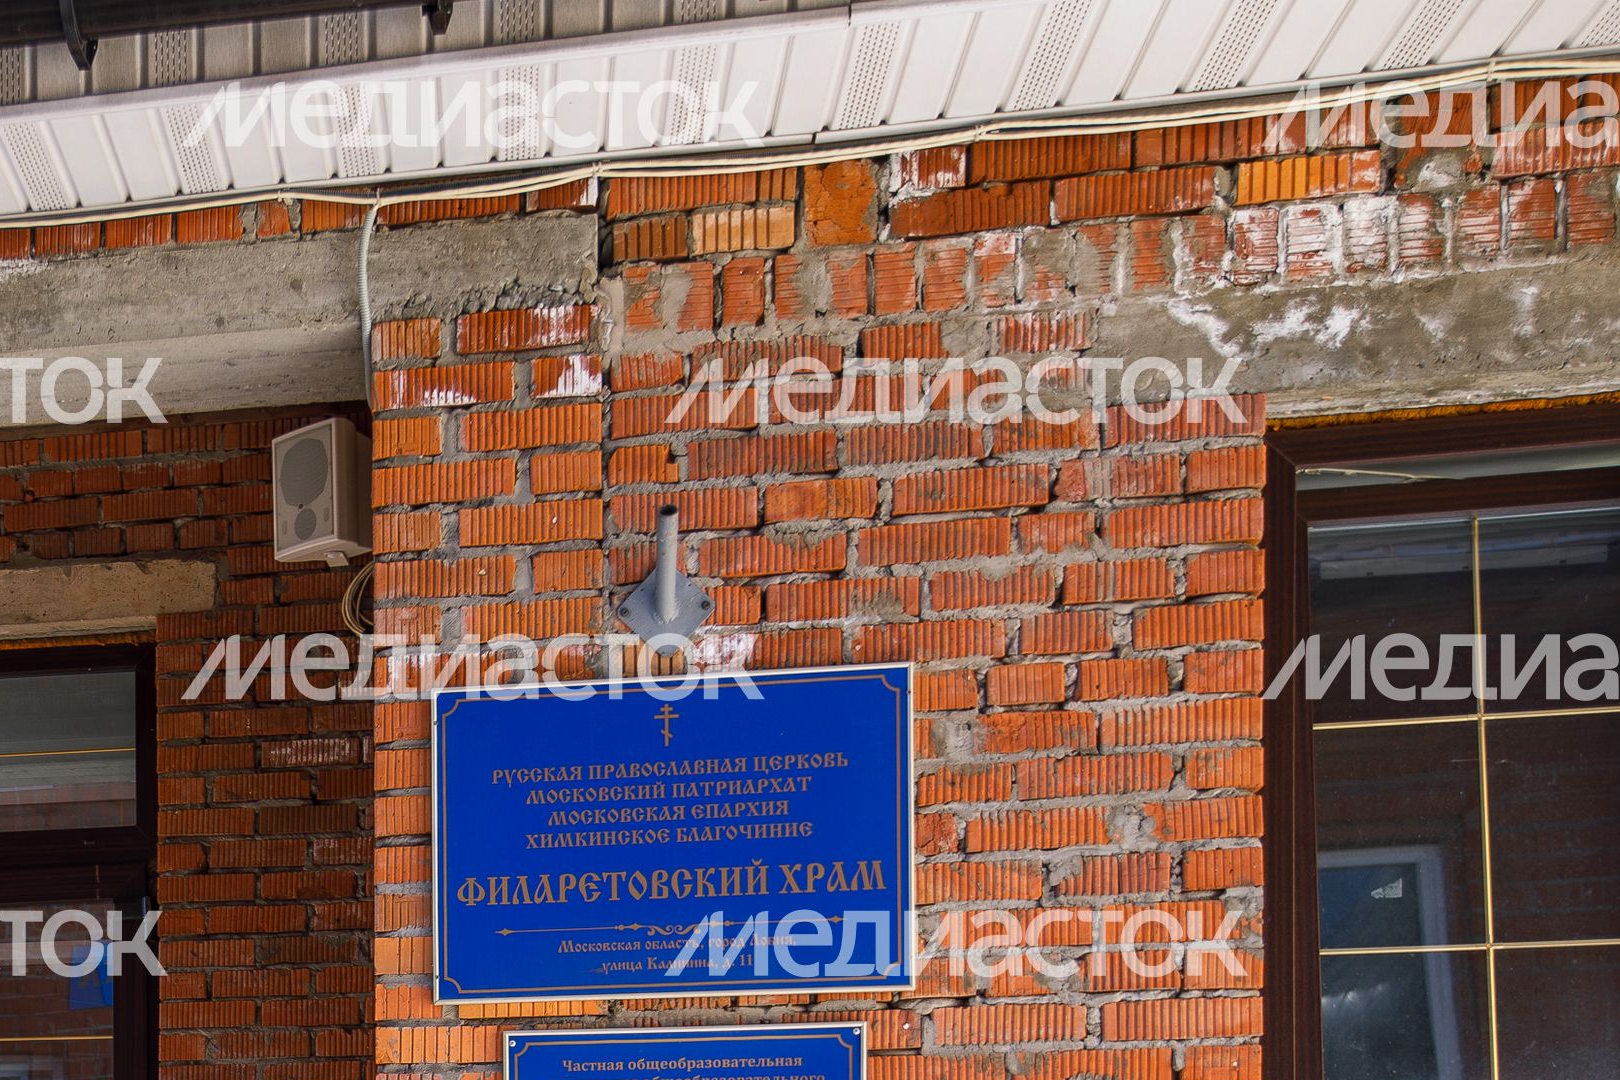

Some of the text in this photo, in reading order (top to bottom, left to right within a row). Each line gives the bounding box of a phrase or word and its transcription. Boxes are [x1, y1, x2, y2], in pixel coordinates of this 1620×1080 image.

[492, 752, 848, 788] РУССКАЯ ПРАВОСЛАВНАЯ ЦЕРКОВЬ
[526, 776, 812, 804] МОСКОВСКИЙ ПАТРИАРХАТ
[548, 800, 789, 826] МОСКОВСКАЯ ЕПАРХИЯ
[525, 821, 813, 849] ХИМКИНСКОЕ БЛАГОЧИНИЕ
[457, 858, 887, 906] ФИЛАРЕТОВСКИЙ ХРАМ
[557, 940, 641, 953] Московская
[645, 937, 704, 951] область,
[601, 960, 643, 975] улица
[647, 956, 718, 971] Калинина,
[739, 954, 752, 967] 11
[562, 1057, 803, 1072] Частная общеобразовательная
